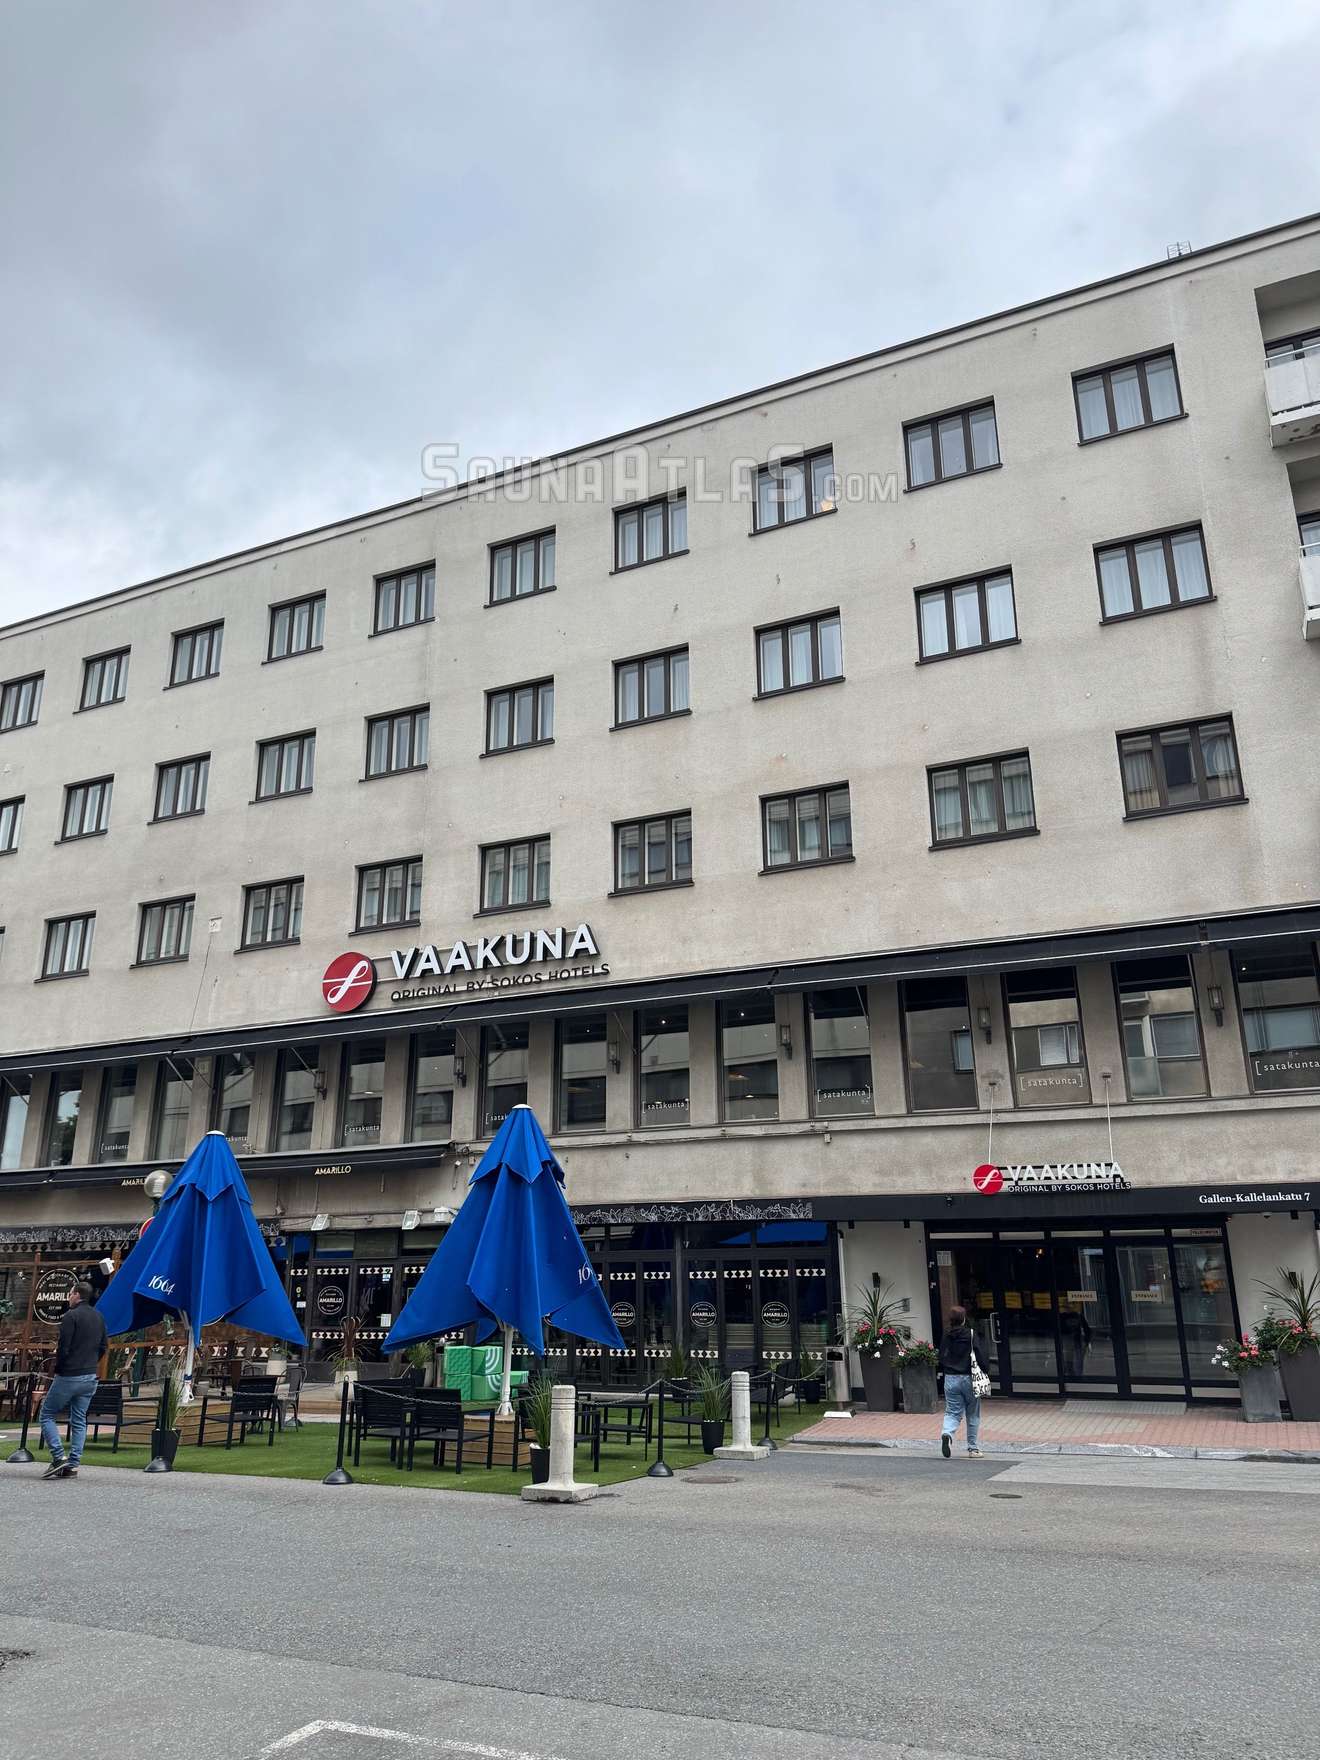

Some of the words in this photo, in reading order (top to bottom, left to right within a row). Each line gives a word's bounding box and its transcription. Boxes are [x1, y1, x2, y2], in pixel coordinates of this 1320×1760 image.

[391, 923, 600, 980] VAAKUNA
[391, 984, 458, 1002] ORIGINAL
[466, 979, 485, 993] BY
[491, 972, 542, 989] SOKOS
[549, 963, 611, 981] HOTELS
[314, 1165, 352, 1176] AMARILLO
[1006, 1161, 1124, 1182] VAAKUNA
[1008, 1183, 1049, 1194] ORIGINAL
[1051, 1183, 1062, 1192] BY
[1065, 1182, 1095, 1192] SOKOS
[1097, 1181, 1132, 1191] HOTELS
[1199, 1191, 1302, 1205] Gallen-Kallelankatu
[1304, 1191, 1311, 1201] 7
[577, 1261, 592, 1285] 16
[148, 1275, 176, 1295] 1664
[35, 1291, 71, 1302] AMARILL
